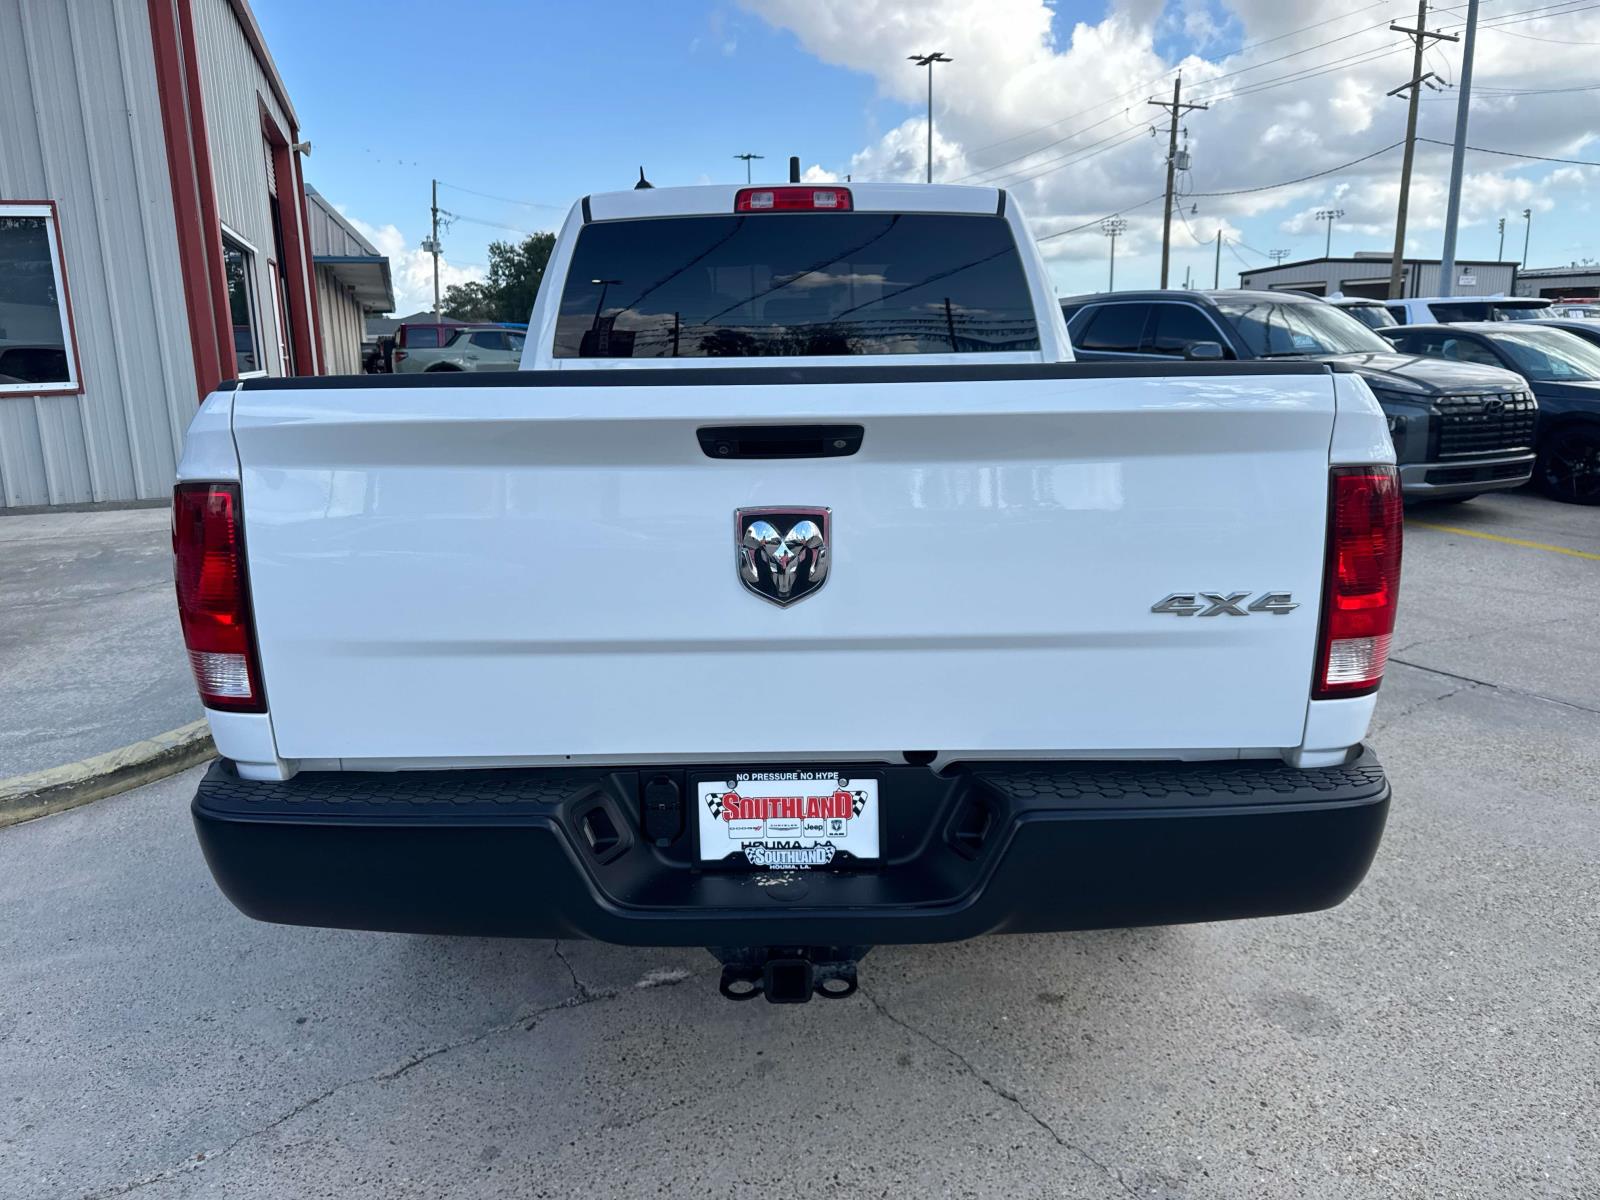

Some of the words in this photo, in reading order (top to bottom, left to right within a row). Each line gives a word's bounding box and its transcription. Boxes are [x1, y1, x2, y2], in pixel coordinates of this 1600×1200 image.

[1151, 592, 1300, 617] 4X4
[736, 773, 750, 781] NO
[751, 773, 798, 781] PRESSURE
[800, 772, 814, 780] NO
[815, 772, 839, 780] HYPE
[804, 823, 823, 831] Jeep
